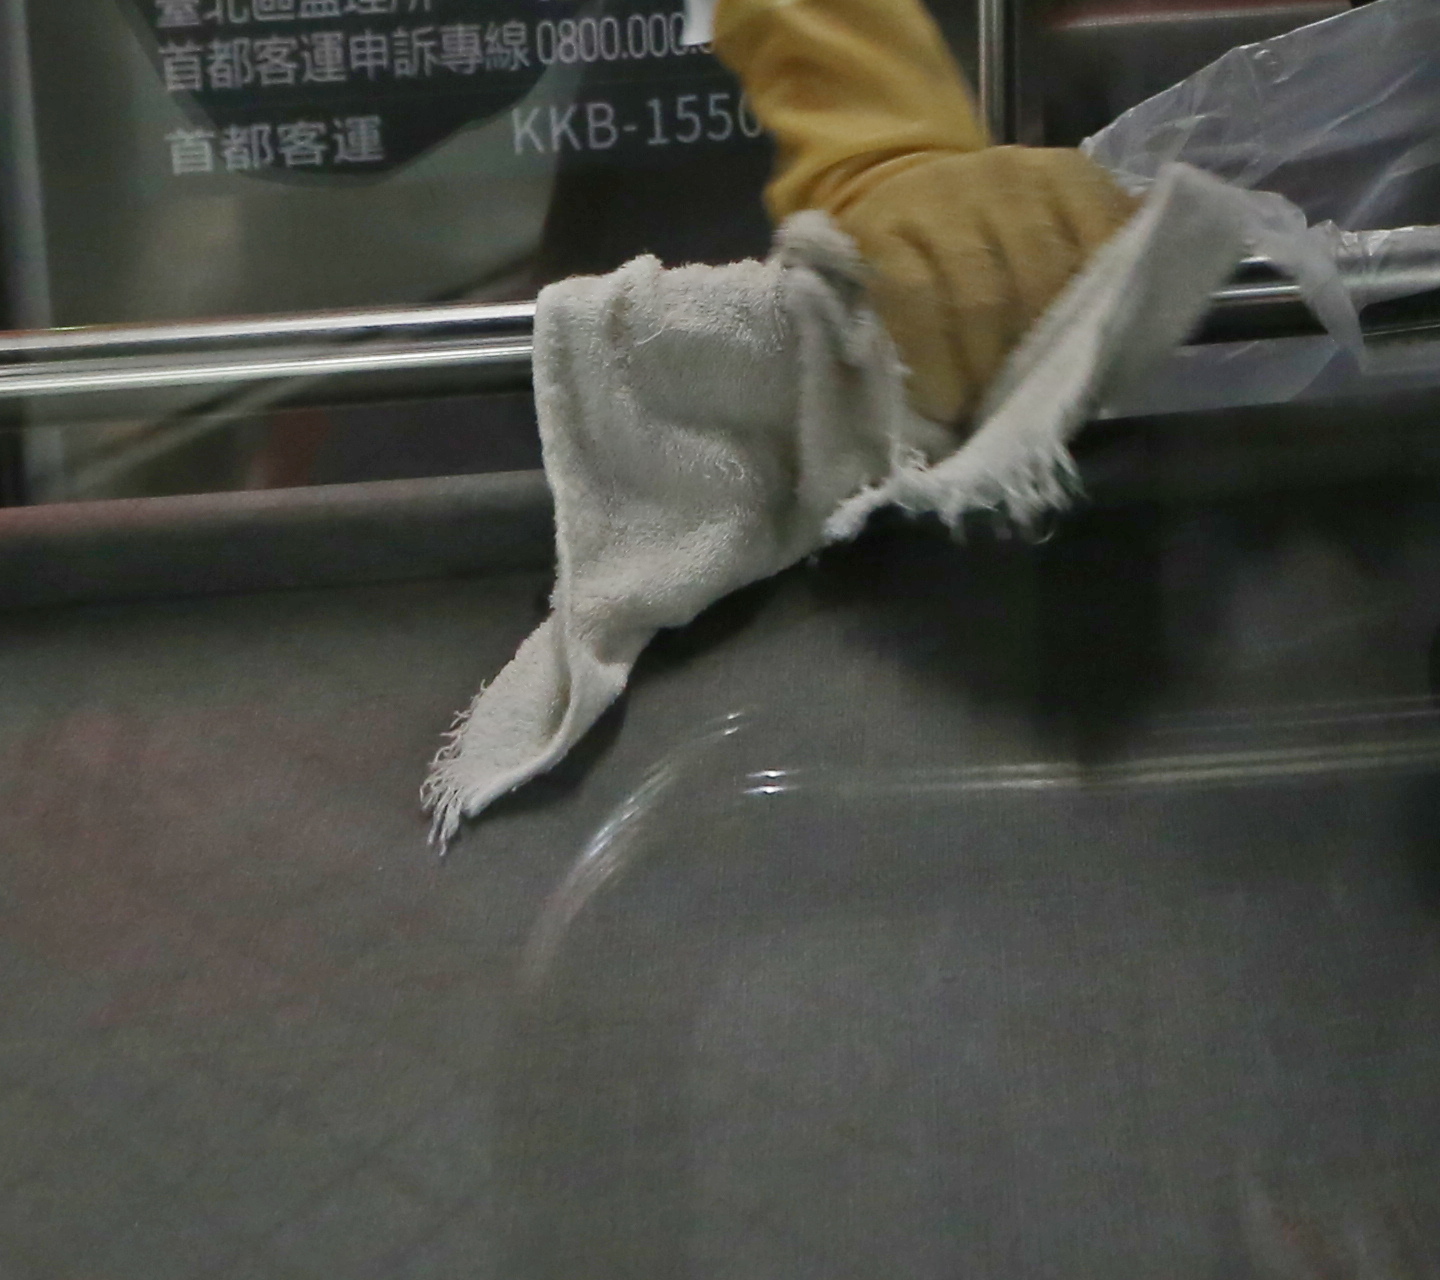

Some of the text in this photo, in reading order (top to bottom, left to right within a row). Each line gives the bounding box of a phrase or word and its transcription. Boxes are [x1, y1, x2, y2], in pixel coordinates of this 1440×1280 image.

[158, 12, 715, 93] 首都客運申訴專線 0800.000.
[164, 115, 384, 175] 首都客運
